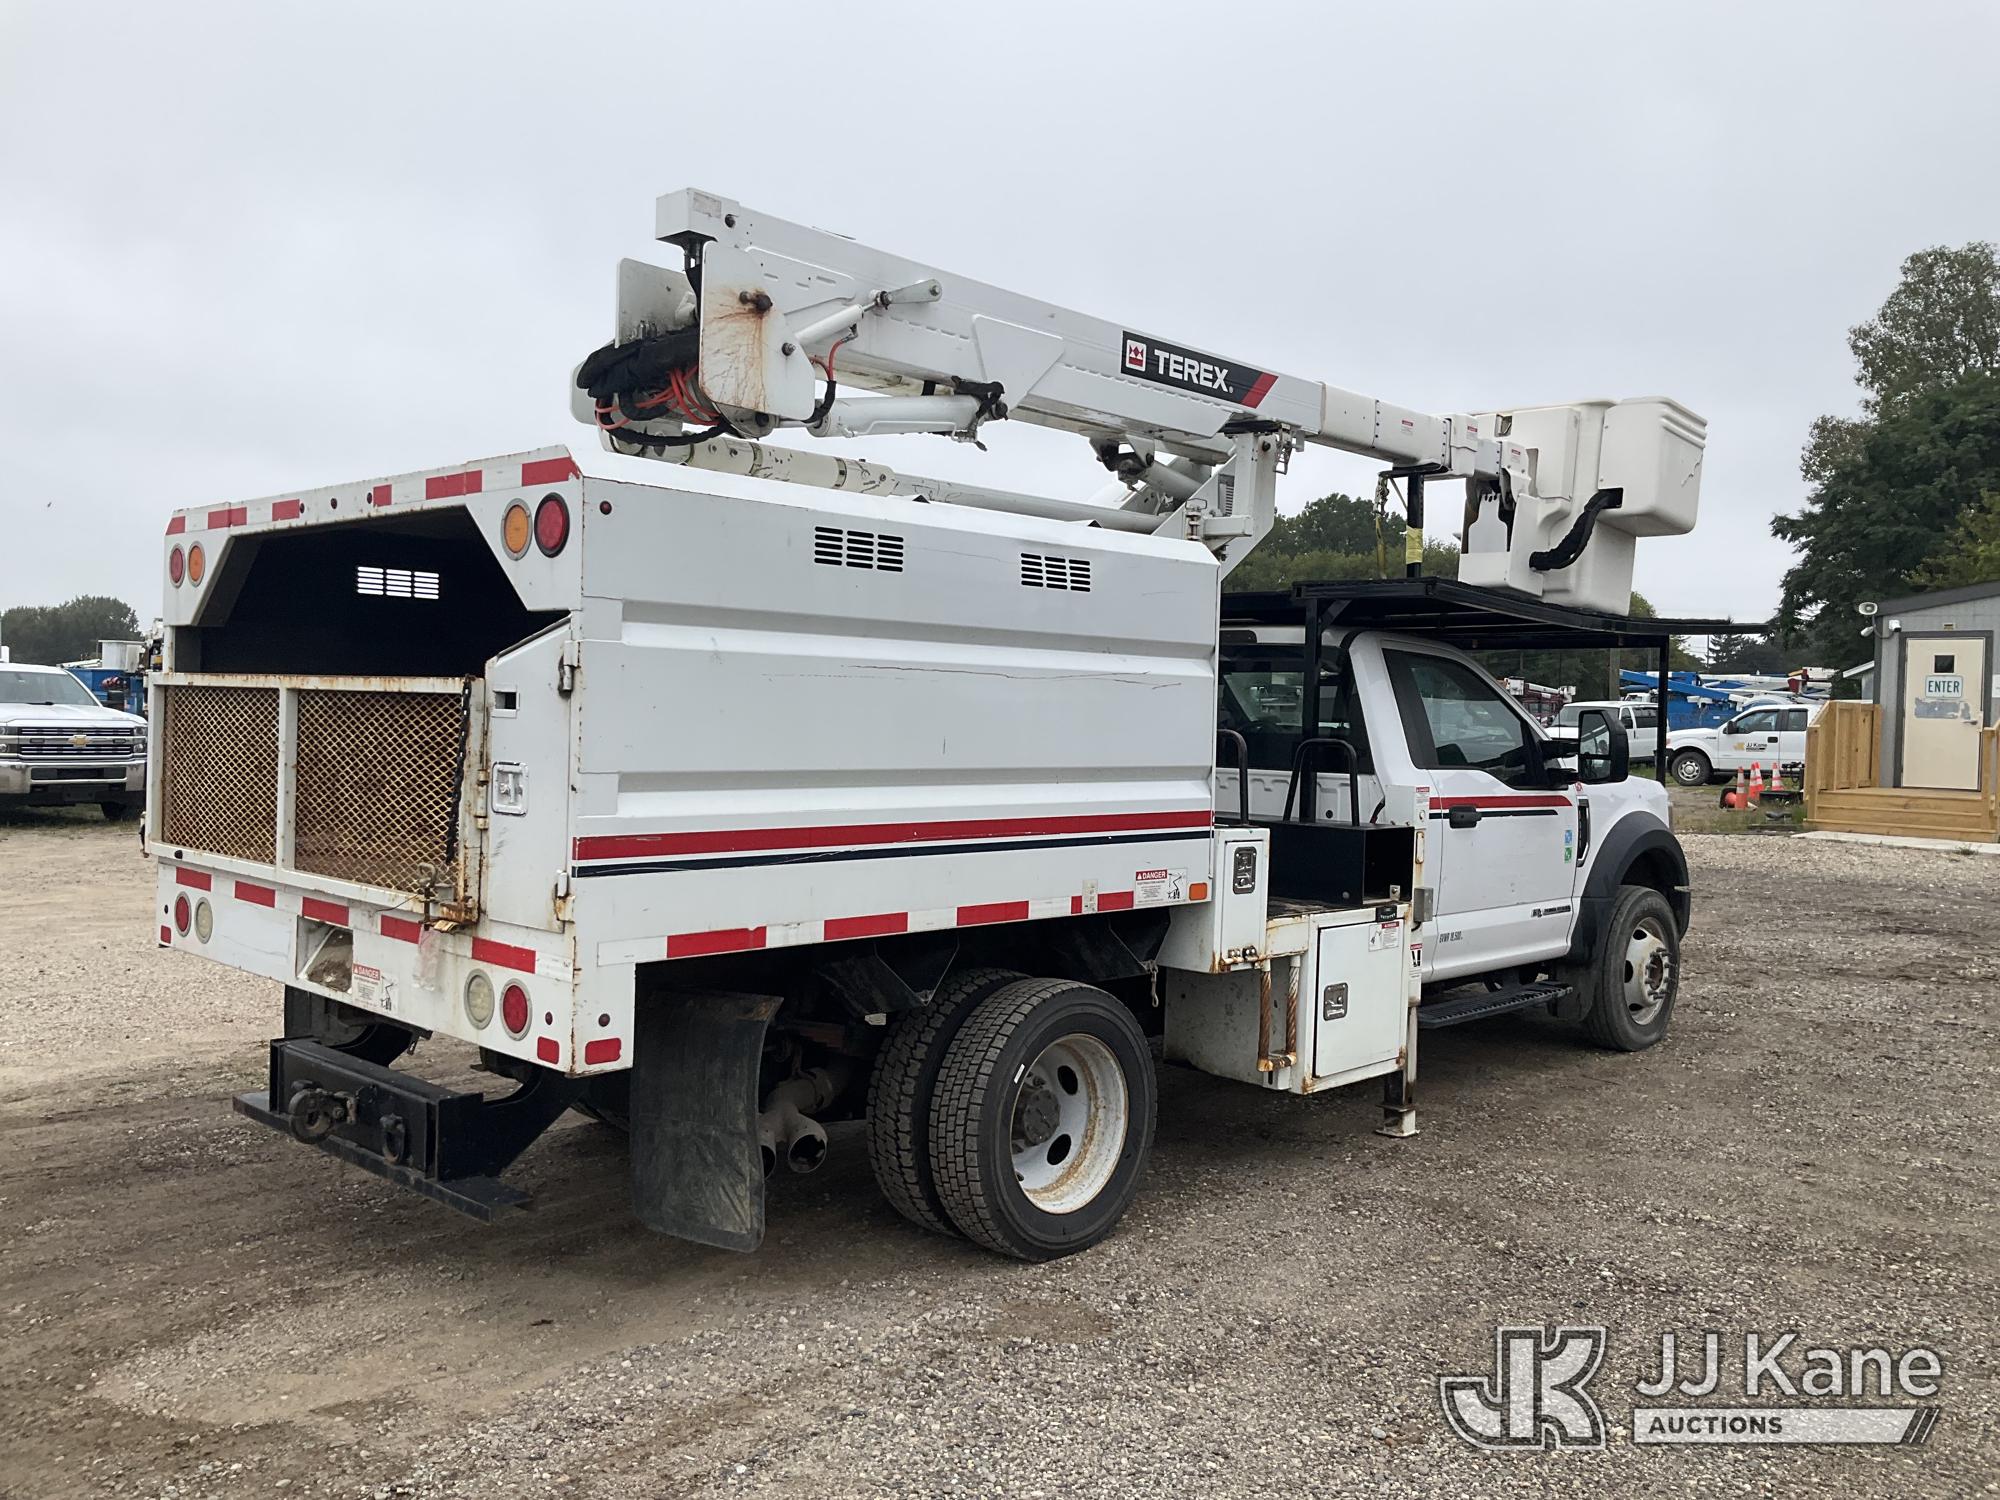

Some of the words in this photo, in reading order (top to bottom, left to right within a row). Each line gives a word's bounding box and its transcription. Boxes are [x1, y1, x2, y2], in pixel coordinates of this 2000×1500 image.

[1154, 349, 1228, 392] TEREX
[1928, 681, 1960, 693] ENTER
[1142, 871, 1166, 880] DANGER
[358, 966, 380, 980] DANGER
